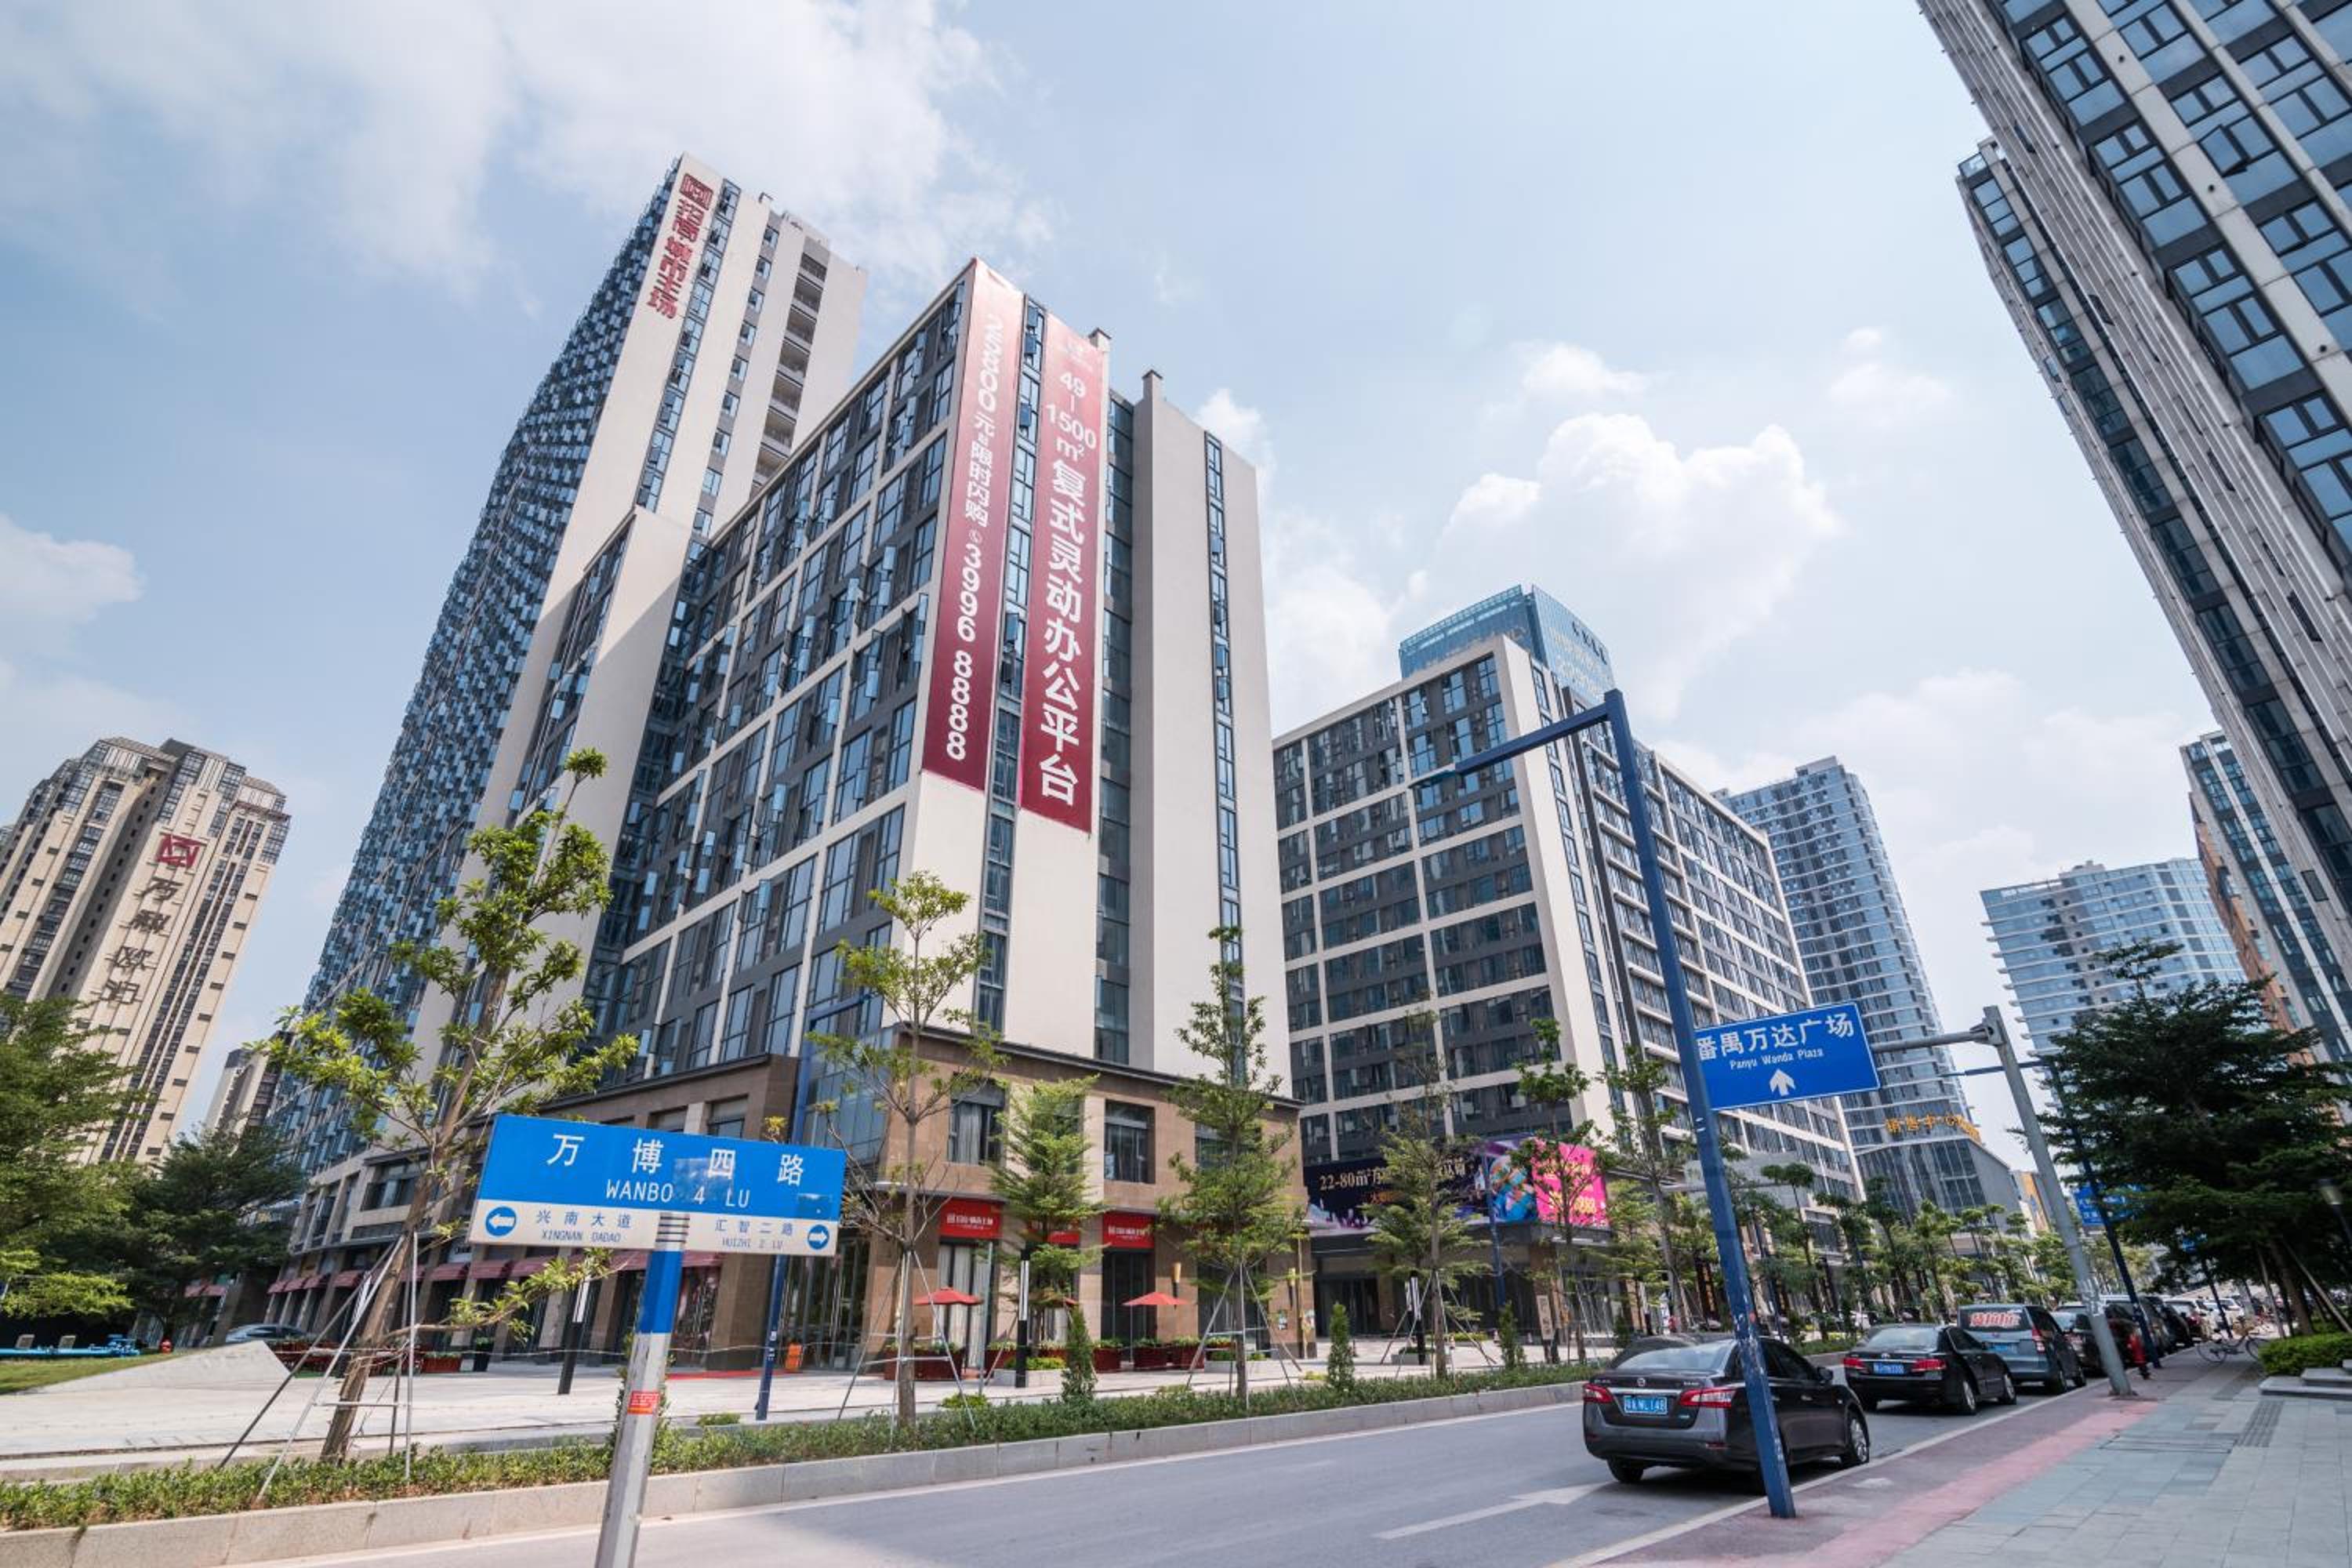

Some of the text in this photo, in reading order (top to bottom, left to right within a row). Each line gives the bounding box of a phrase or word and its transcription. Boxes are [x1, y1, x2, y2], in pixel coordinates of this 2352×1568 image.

[1040, 459, 1087, 806] 复式灵动办公平台
[946, 543, 982, 761] 3996 8888
[1697, 1012, 1855, 1061] 番禺万达广场
[1730, 1047, 1824, 1070] Panyu Wanda Plaza
[546, 1134, 804, 1186] 万博四路
[605, 1178, 751, 1208] WANBO 4 LU
[535, 1208, 632, 1229] 兴南大道
[714, 1218, 793, 1236] 汇智二路
[541, 1229, 622, 1243] XINGNAN DADAO
